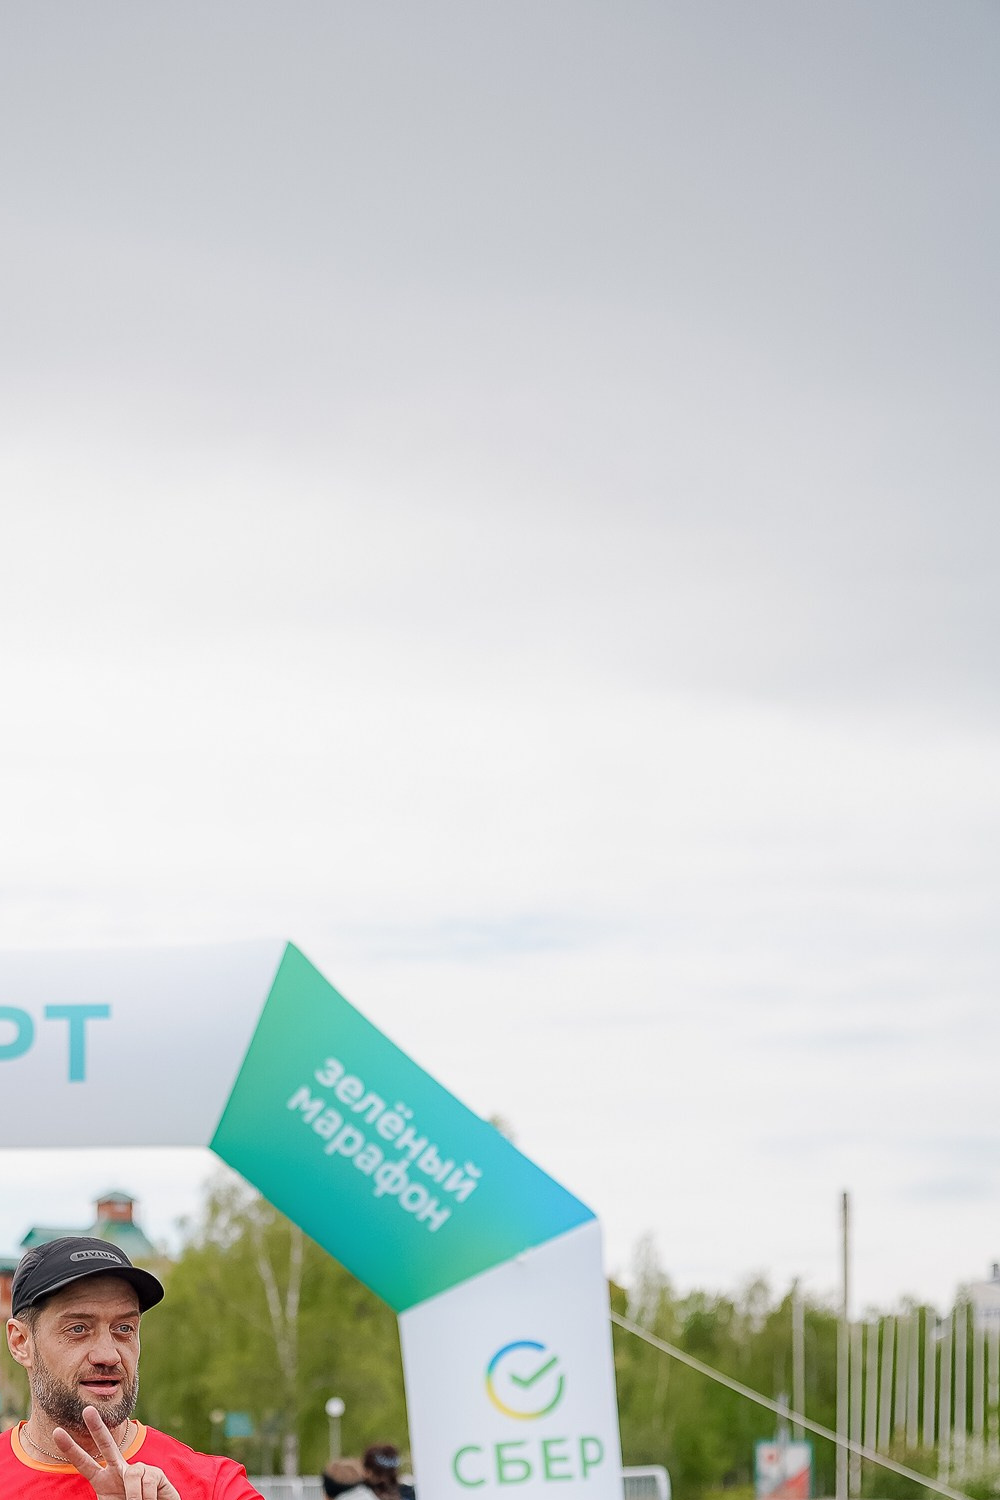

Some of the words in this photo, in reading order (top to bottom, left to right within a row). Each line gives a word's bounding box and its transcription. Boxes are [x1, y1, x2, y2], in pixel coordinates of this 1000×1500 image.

[287, 1085, 451, 1232] марафон
[314, 1057, 482, 1203] зелёный
[452, 1435, 604, 1488] СБЕР
